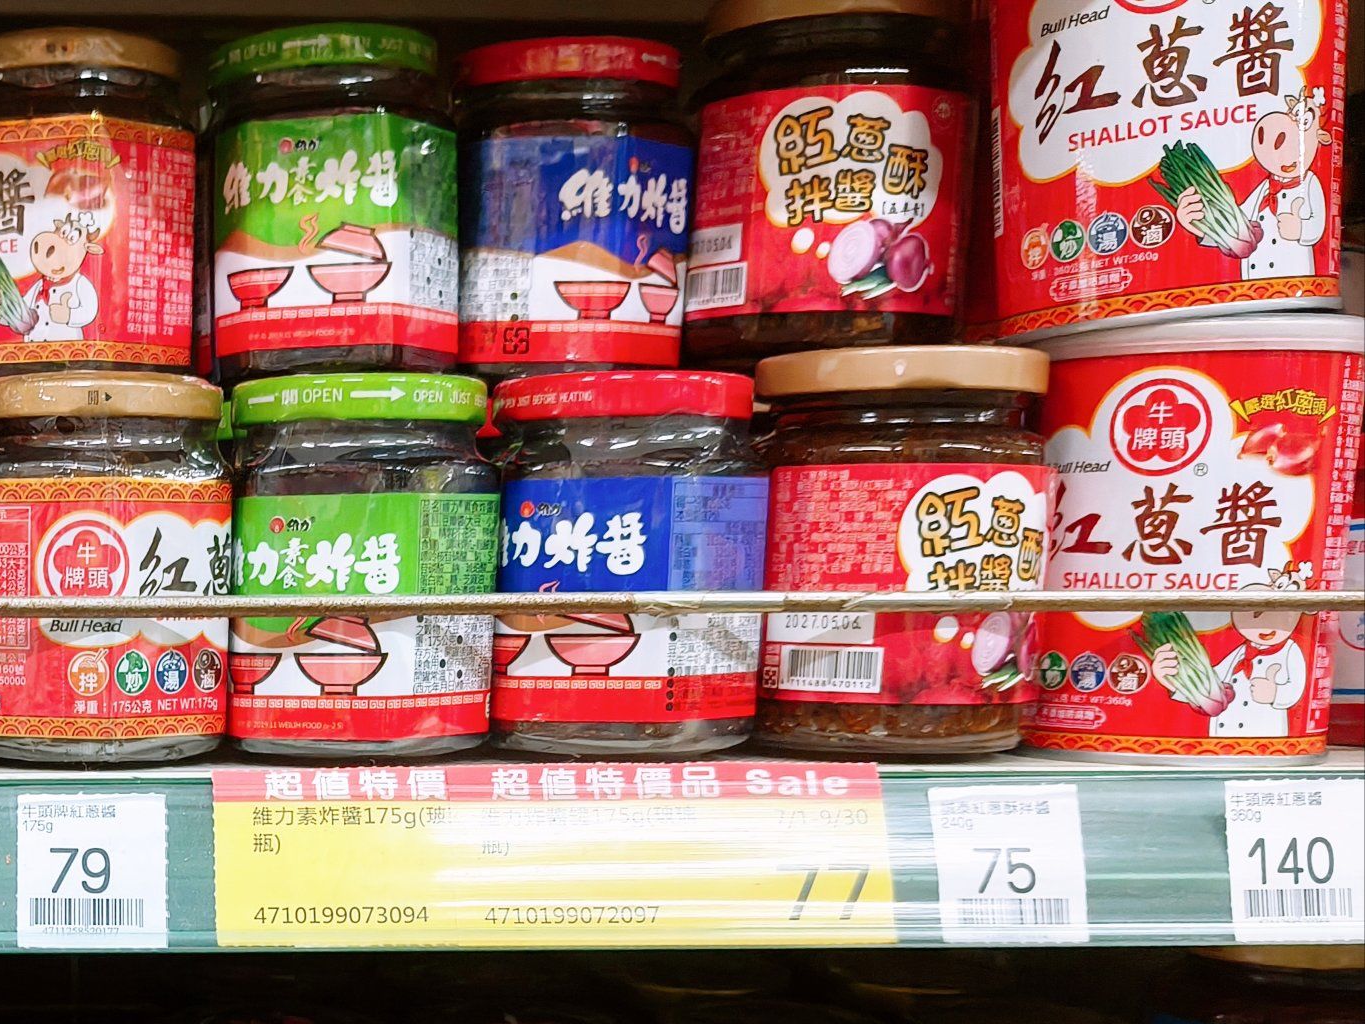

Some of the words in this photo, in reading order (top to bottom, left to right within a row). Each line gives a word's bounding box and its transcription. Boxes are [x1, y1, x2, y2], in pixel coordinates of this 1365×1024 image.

[1068, 115, 1170, 152] SHALLOT
[1181, 104, 1258, 132] SAUCE
[303, 388, 343, 403] OPEN
[49, 619, 78, 633] Bull
[81, 619, 123, 633] Head
[491, 767, 720, 800] 超值特價品
[745, 769, 849, 797] Sale
[49, 847, 111, 894] 79
[973, 847, 1036, 894] 75
[1248, 836, 1335, 885] 140
[776, 863, 871, 921] 77
[254, 906, 430, 925] 4710199073094
[485, 906, 660, 925] 4710199072097
